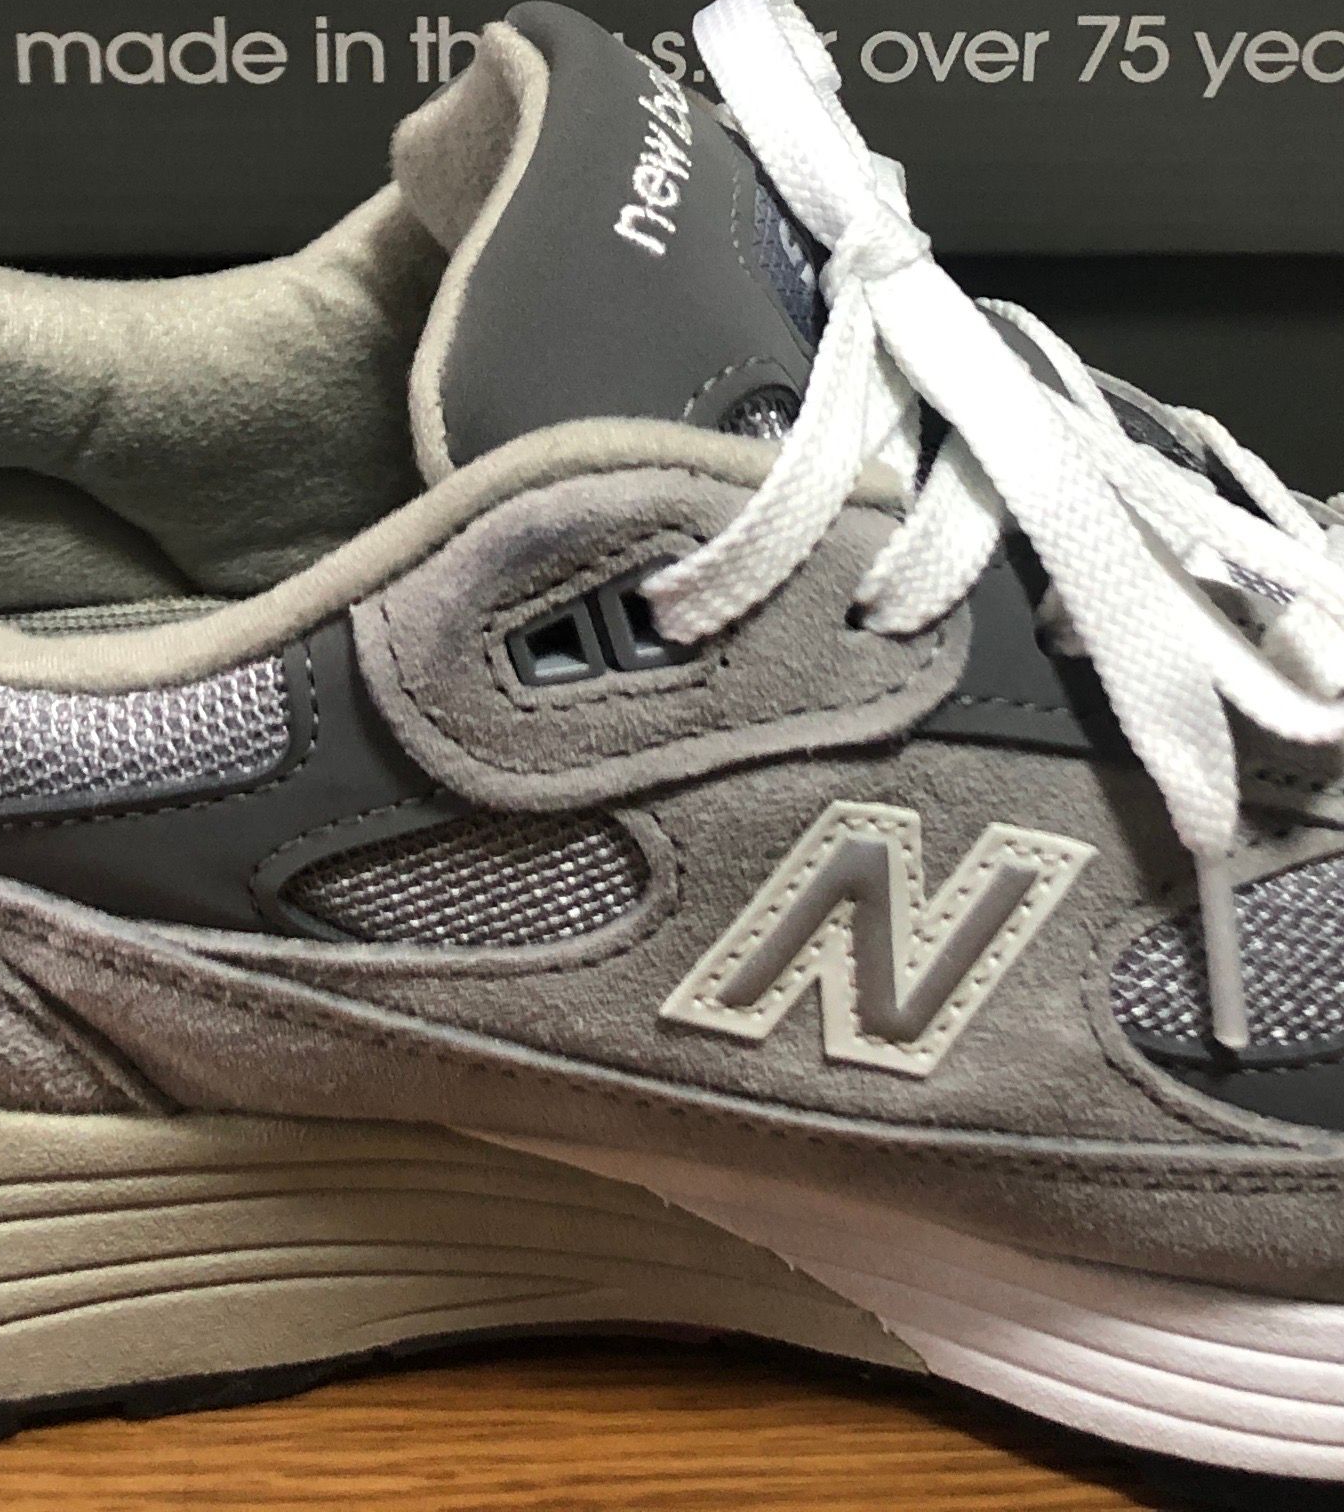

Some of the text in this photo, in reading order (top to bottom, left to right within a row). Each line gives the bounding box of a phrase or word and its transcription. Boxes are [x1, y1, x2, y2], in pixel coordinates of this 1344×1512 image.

[16, 15, 288, 85] made
[315, 15, 386, 85] in
[409, 15, 484, 85] th
[859, 29, 1051, 84] over
[1076, 14, 1171, 84] 75
[659, 798, 1100, 1080] N
